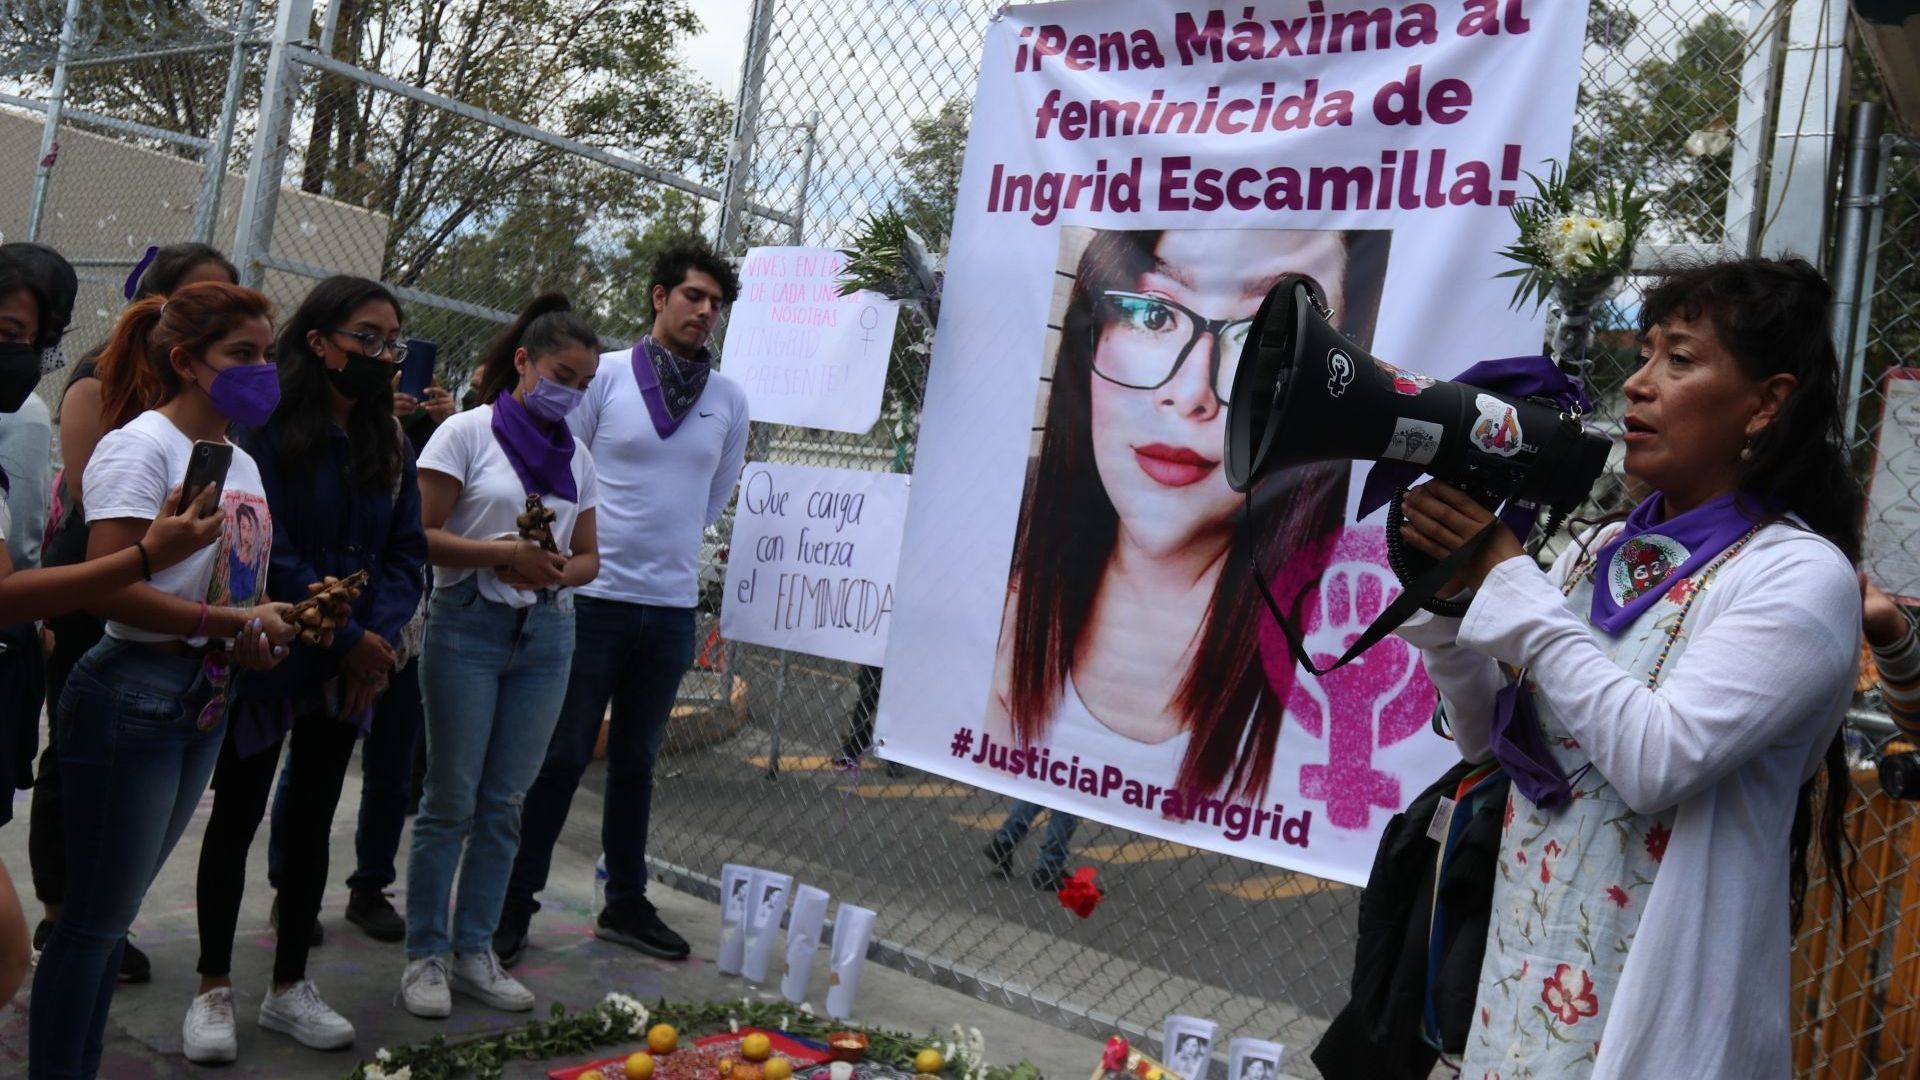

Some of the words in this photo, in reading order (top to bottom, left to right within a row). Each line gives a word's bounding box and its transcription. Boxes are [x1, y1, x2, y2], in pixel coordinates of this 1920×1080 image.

[1014, 25, 1164, 73] ¡Pena
[1173, 4, 1439, 66] Máxima
[1456, 0, 1531, 36] al
[1035, 79, 1355, 141] feminicida
[1373, 65, 1473, 126] de
[986, 157, 1143, 227] Ingrid
[1158, 144, 1522, 213] Escamilla!
[748, 256, 787, 278] VIVES
[795, 256, 815, 278] EN
[750, 283, 765, 302] DE
[772, 283, 805, 304] CADA
[771, 306, 839, 327] NOSOTRAS
[746, 470, 789, 519] Que
[807, 491, 865, 533] caiga
[756, 535, 784, 563] con
[797, 527, 855, 567] fuerza
[737, 568, 757, 604] el
[774, 573, 894, 637] FEMINICIDA
[950, 727, 1312, 849] #JusticiaParaIngrid
